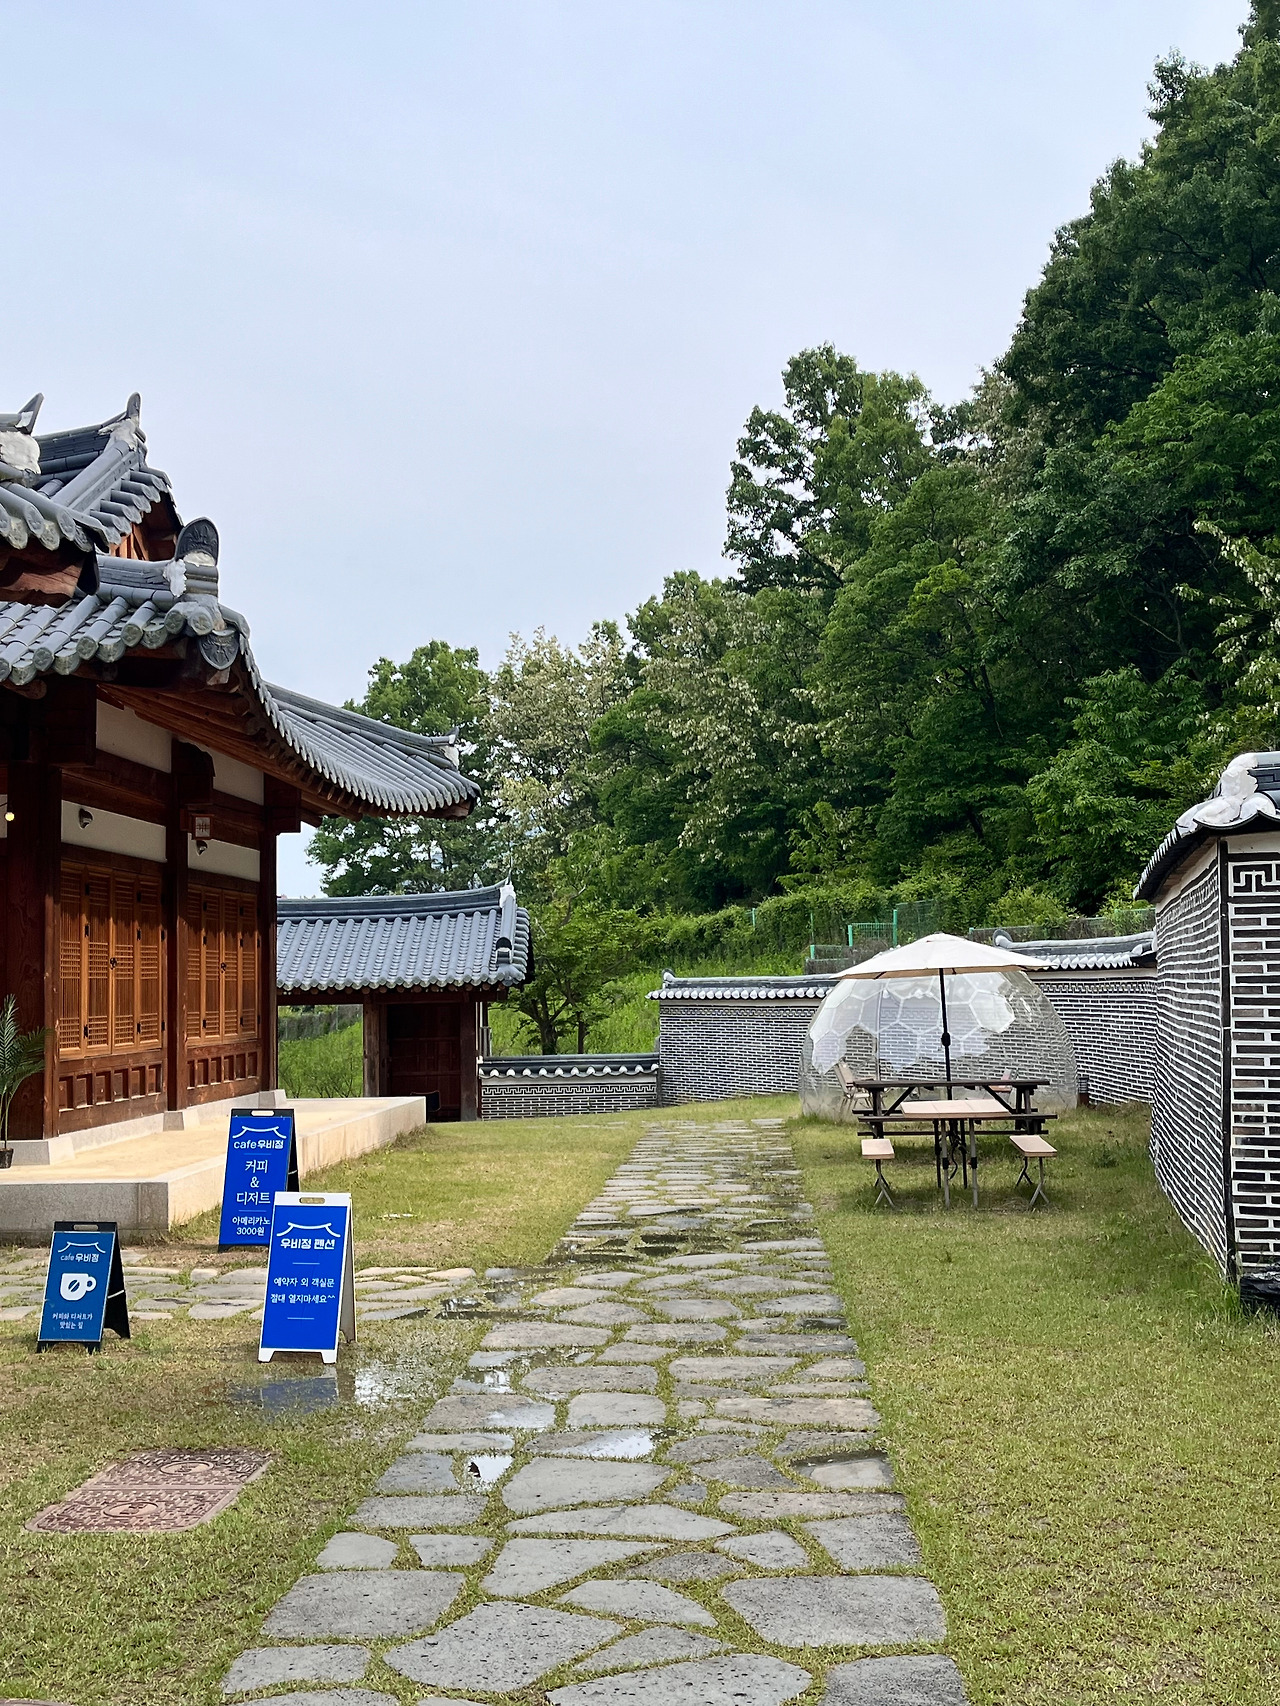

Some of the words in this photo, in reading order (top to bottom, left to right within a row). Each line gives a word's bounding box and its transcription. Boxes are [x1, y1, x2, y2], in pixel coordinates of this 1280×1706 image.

[245, 1159, 268, 1174] 커피
[250, 1176, 260, 1188] &
[236, 1191, 271, 1206] 디저트
[232, 1216, 271, 1226] 아메리카노
[236, 1227, 265, 1237] 3000원
[280, 1238, 312, 1250] 우비정
[314, 1238, 336, 1250] 펜션
[273, 1277, 298, 1287] 예약자
[300, 1277, 309, 1287] 외
[311, 1277, 335, 1288] 객실문
[270, 1294, 286, 1304] 절대
